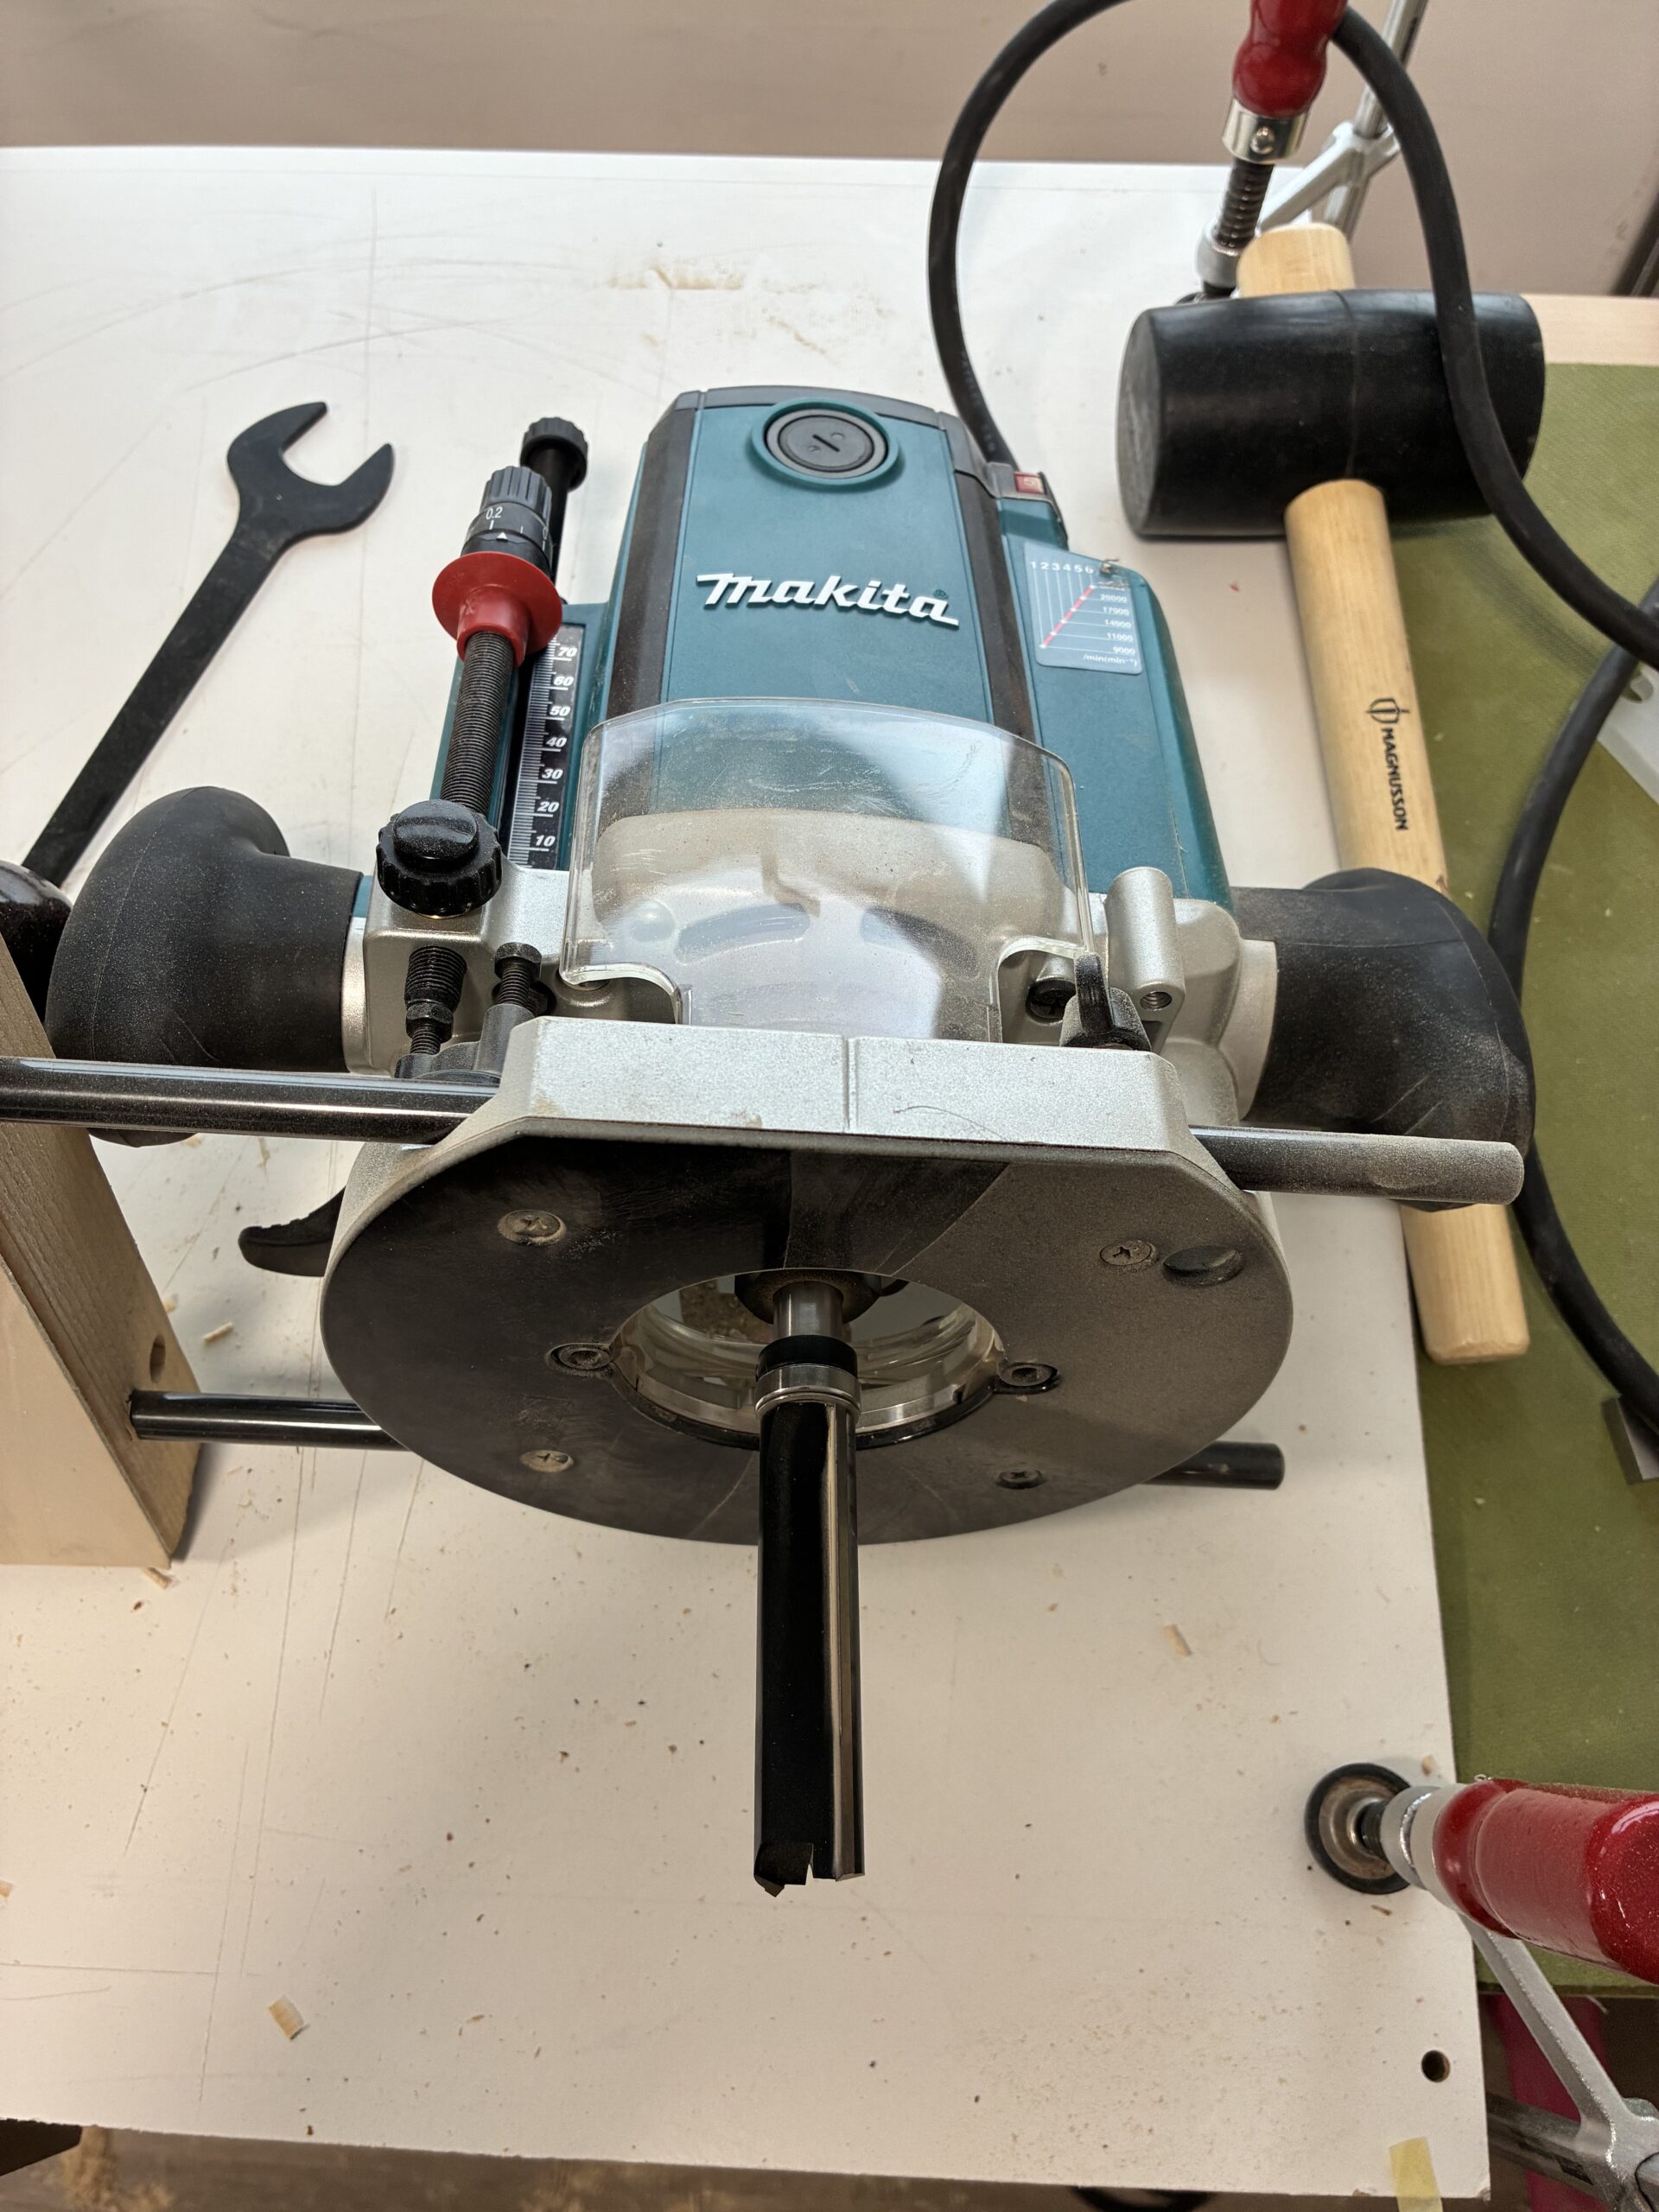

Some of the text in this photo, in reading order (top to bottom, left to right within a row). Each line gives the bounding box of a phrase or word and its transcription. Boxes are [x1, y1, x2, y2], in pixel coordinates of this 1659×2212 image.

[486, 506, 503, 519] 0.2
[557, 647, 577, 658] 70
[553, 676, 574, 687] 60
[550, 705, 571, 716] 50
[546, 737, 567, 747] 40
[542, 768, 563, 779] 30
[1382, 728, 1408, 830] MAGNUSSON
[537, 802, 560, 812] 20
[535, 835, 556, 847] 10
